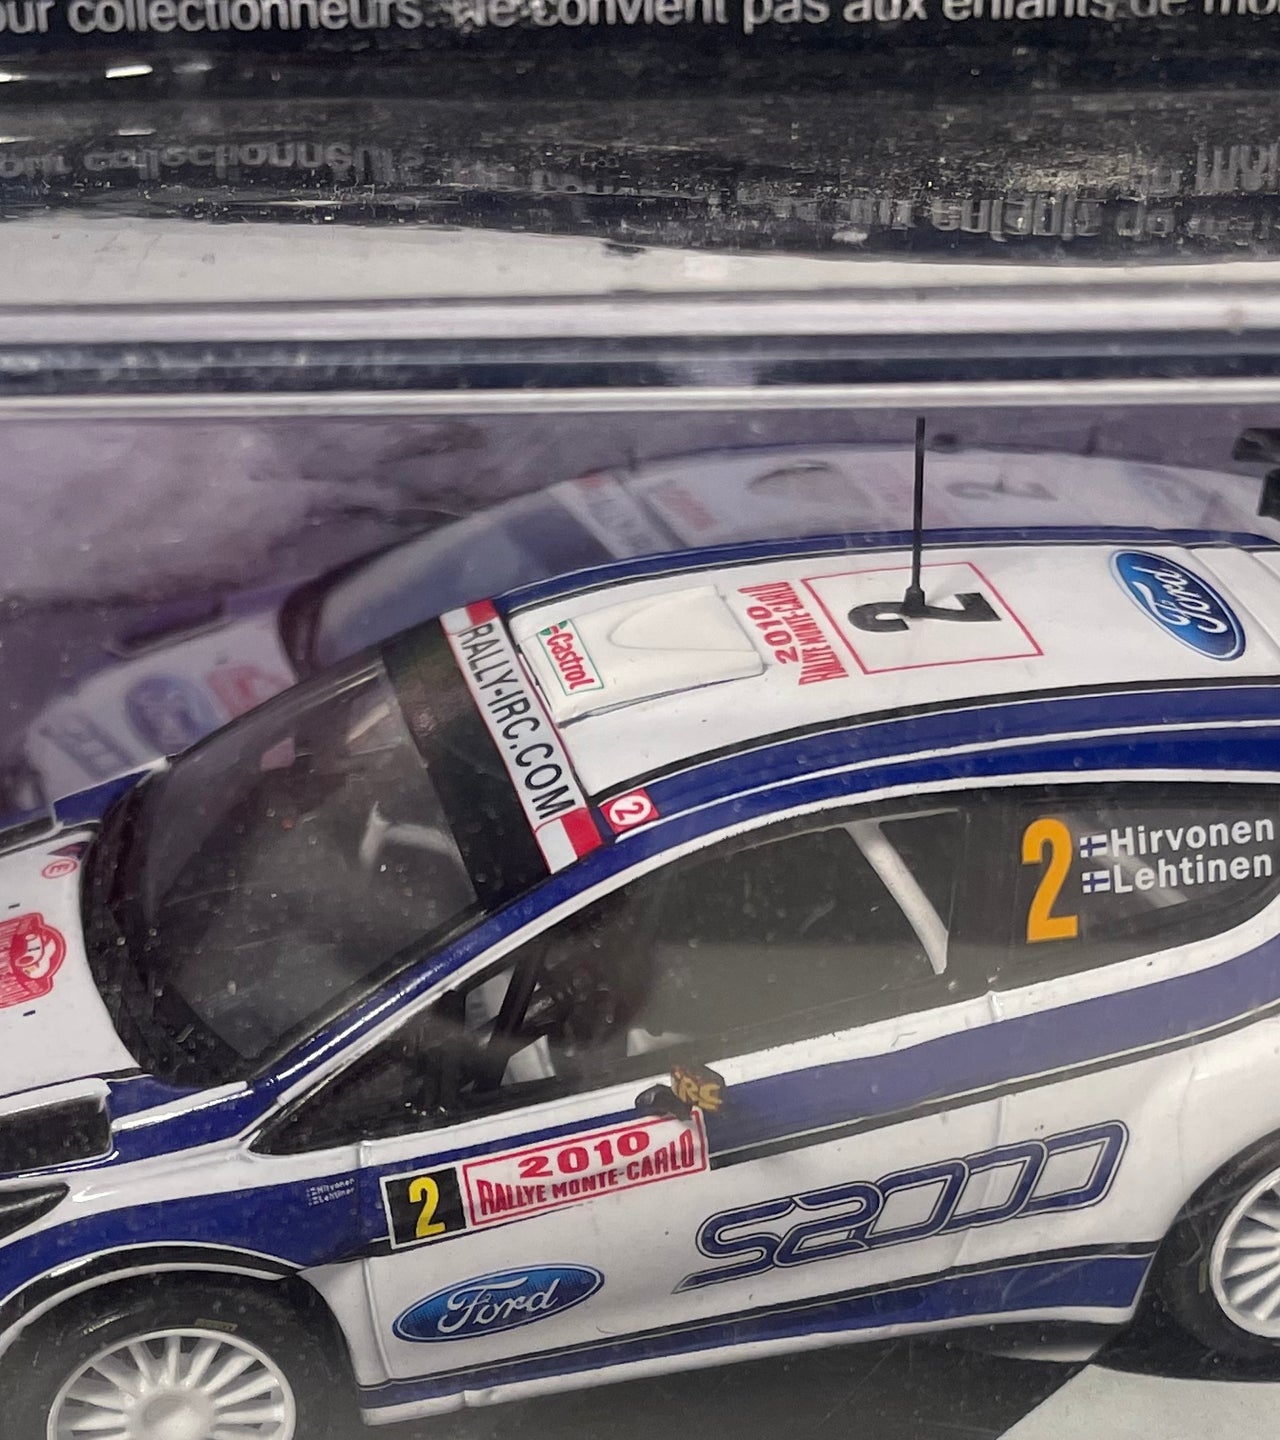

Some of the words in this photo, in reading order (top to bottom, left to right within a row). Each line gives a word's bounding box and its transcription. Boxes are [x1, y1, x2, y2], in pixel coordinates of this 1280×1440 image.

[742, 0, 830, 34] pas
[1130, 565, 1228, 634] Ford
[546, 631, 595, 690] Castrol
[746, 605, 800, 665] 2010
[458, 622, 576, 820] RALLY-IRC.COM
[614, 801, 644, 822] 2
[1110, 817, 1274, 857] Hirvonen
[1021, 817, 1078, 944] 2
[1113, 852, 1272, 894] Lehtinen
[476, 1179, 548, 1217] RALLYE
[552, 1128, 695, 1201] MONTE-CARLO
[518, 1130, 650, 1179] 2010
[408, 1177, 446, 1239] 2
[672, 1119, 1129, 1295] S2000
[437, 1275, 562, 1333] Ford
